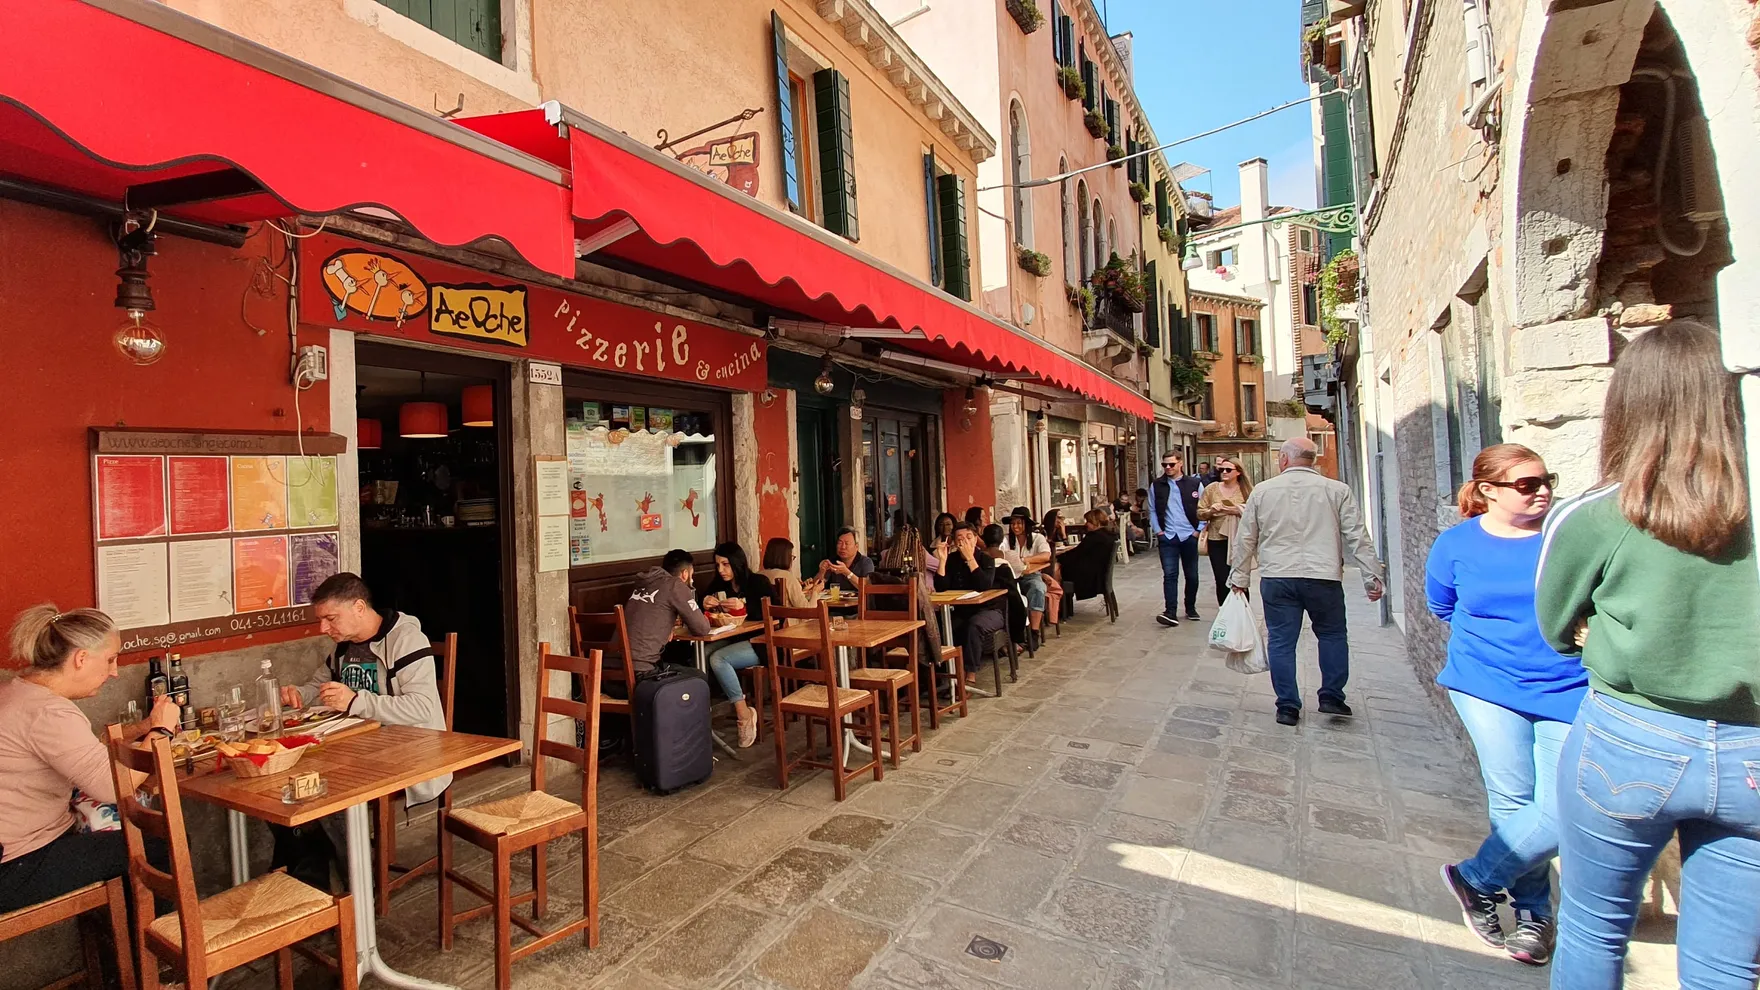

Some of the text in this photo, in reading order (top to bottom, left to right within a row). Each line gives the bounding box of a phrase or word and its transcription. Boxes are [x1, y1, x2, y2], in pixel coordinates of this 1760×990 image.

[695, 360, 711, 381] &
[715, 342, 762, 380] cucina
[120, 608, 307, 649] oche.sg@gmail.com 041-5241161
[1212, 629, 1226, 640] BIO
[341, 666, 378, 694] RITAGE
